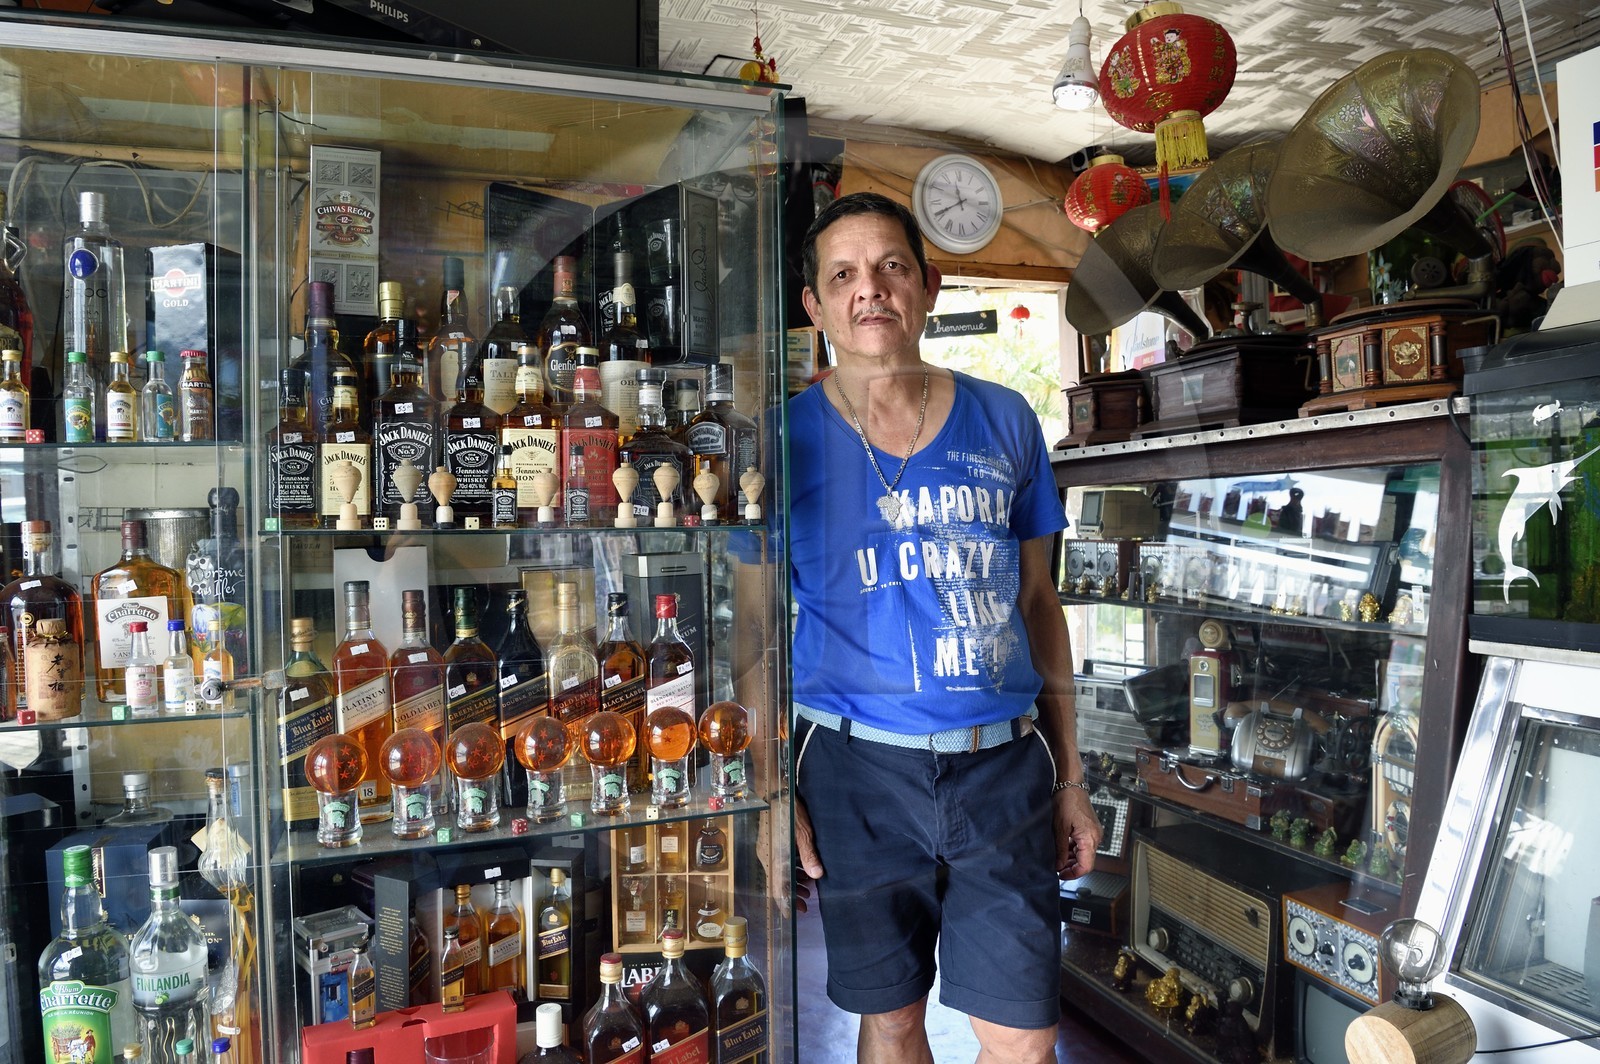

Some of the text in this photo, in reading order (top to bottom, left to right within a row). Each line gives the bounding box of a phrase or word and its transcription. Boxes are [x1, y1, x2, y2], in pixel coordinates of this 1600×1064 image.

[370, 0, 409, 23] PHILIPS
[317, 205, 372, 220] CHIVAS REGAL
[154, 276, 198, 290] MARTINI
[163, 299, 189, 308] GOLD
[933, 321, 987, 334] bienvenue
[379, 426, 433, 448] JACK DANIEL'S
[447, 436, 496, 455] JACK DANIEL'S
[527, 435, 557, 454] DANIEL'S
[271, 450, 289, 463] JACK
[324, 453, 341, 466] JACK
[947, 451, 960, 462] THE
[455, 466, 489, 475] Tennessee
[515, 466, 543, 475] Tenness
[857, 541, 994, 586] U CRAZY
[107, 606, 158, 623] Charrette
[949, 590, 1008, 628] LIKE
[935, 637, 979, 677] ME
[341, 688, 386, 714] PLATINUM
[502, 695, 527, 708] DOUBLE
[602, 687, 646, 709] BLACK LABEL
[395, 699, 442, 723] GOLD LABEL
[448, 696, 497, 721] GREEN LABEL
[292, 712, 333, 736] Blue Label
[363, 788, 374, 797] 18
[136, 972, 191, 992] FINLANDIA
[723, 1024, 763, 1049] Blue Label
[675, 1046, 700, 1064] Label
